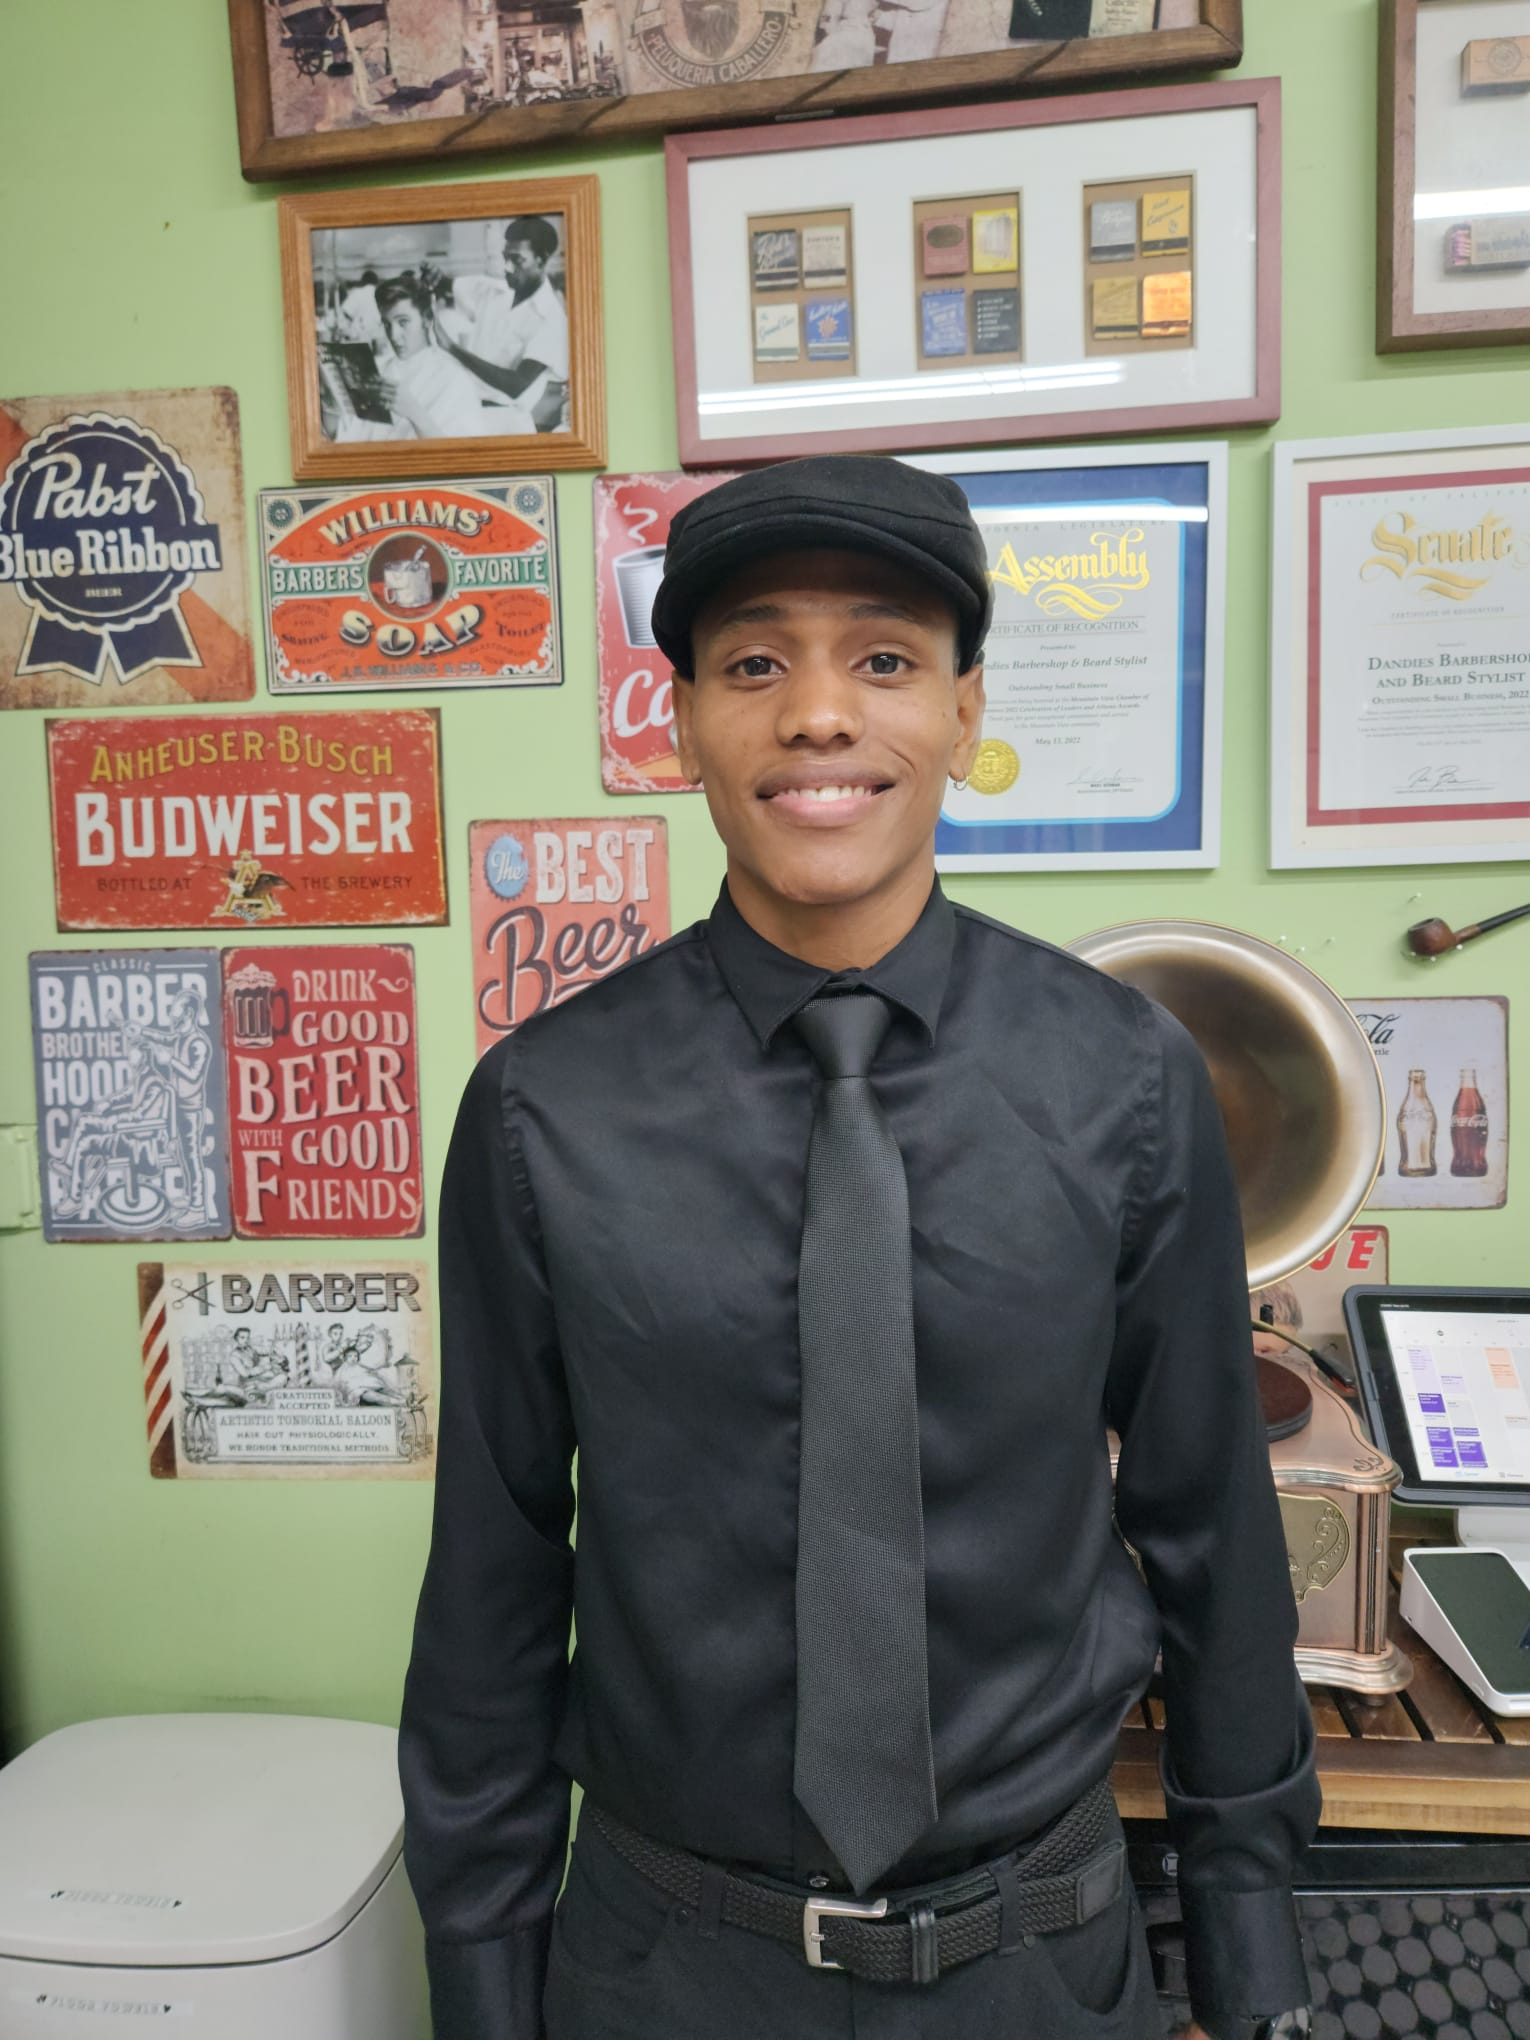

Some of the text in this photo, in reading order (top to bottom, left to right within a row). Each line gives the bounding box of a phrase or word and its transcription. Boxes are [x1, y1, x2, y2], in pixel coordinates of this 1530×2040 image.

[30, 452, 161, 520] Pabst
[0, 527, 221, 582] Blue Ribbon
[984, 528, 1151, 596] Assembly
[1360, 510, 1513, 582] Senate
[272, 556, 546, 593] BARBERS FAVORITE
[339, 605, 484, 657] SOAP
[1046, 622, 1062, 633] OF
[1063, 620, 1140, 632] RECOGNITION
[1012, 658, 1068, 672] Barbershop
[1071, 658, 1081, 668] &
[1082, 657, 1112, 667] Beard
[1114, 655, 1148, 668] Stylist
[75, 791, 414, 867] BUDWEISER
[96, 877, 193, 893] BOTTLED AT
[302, 874, 414, 890] THE BREWERY
[490, 829, 655, 904] The BEST
[92, 958, 152, 974] CLASSIC
[293, 969, 378, 1002] DRINK
[479, 903, 650, 1032] Beer
[291, 1009, 410, 1048] GOOD
[233, 1045, 411, 1125] BEER
[238, 1129, 284, 1147] WITH
[290, 1116, 411, 1174] GOOD
[241, 1150, 418, 1223] FRIENDS
[221, 1271, 422, 1313] BARBER
[278, 1402, 331, 1410] ACCEPTED
